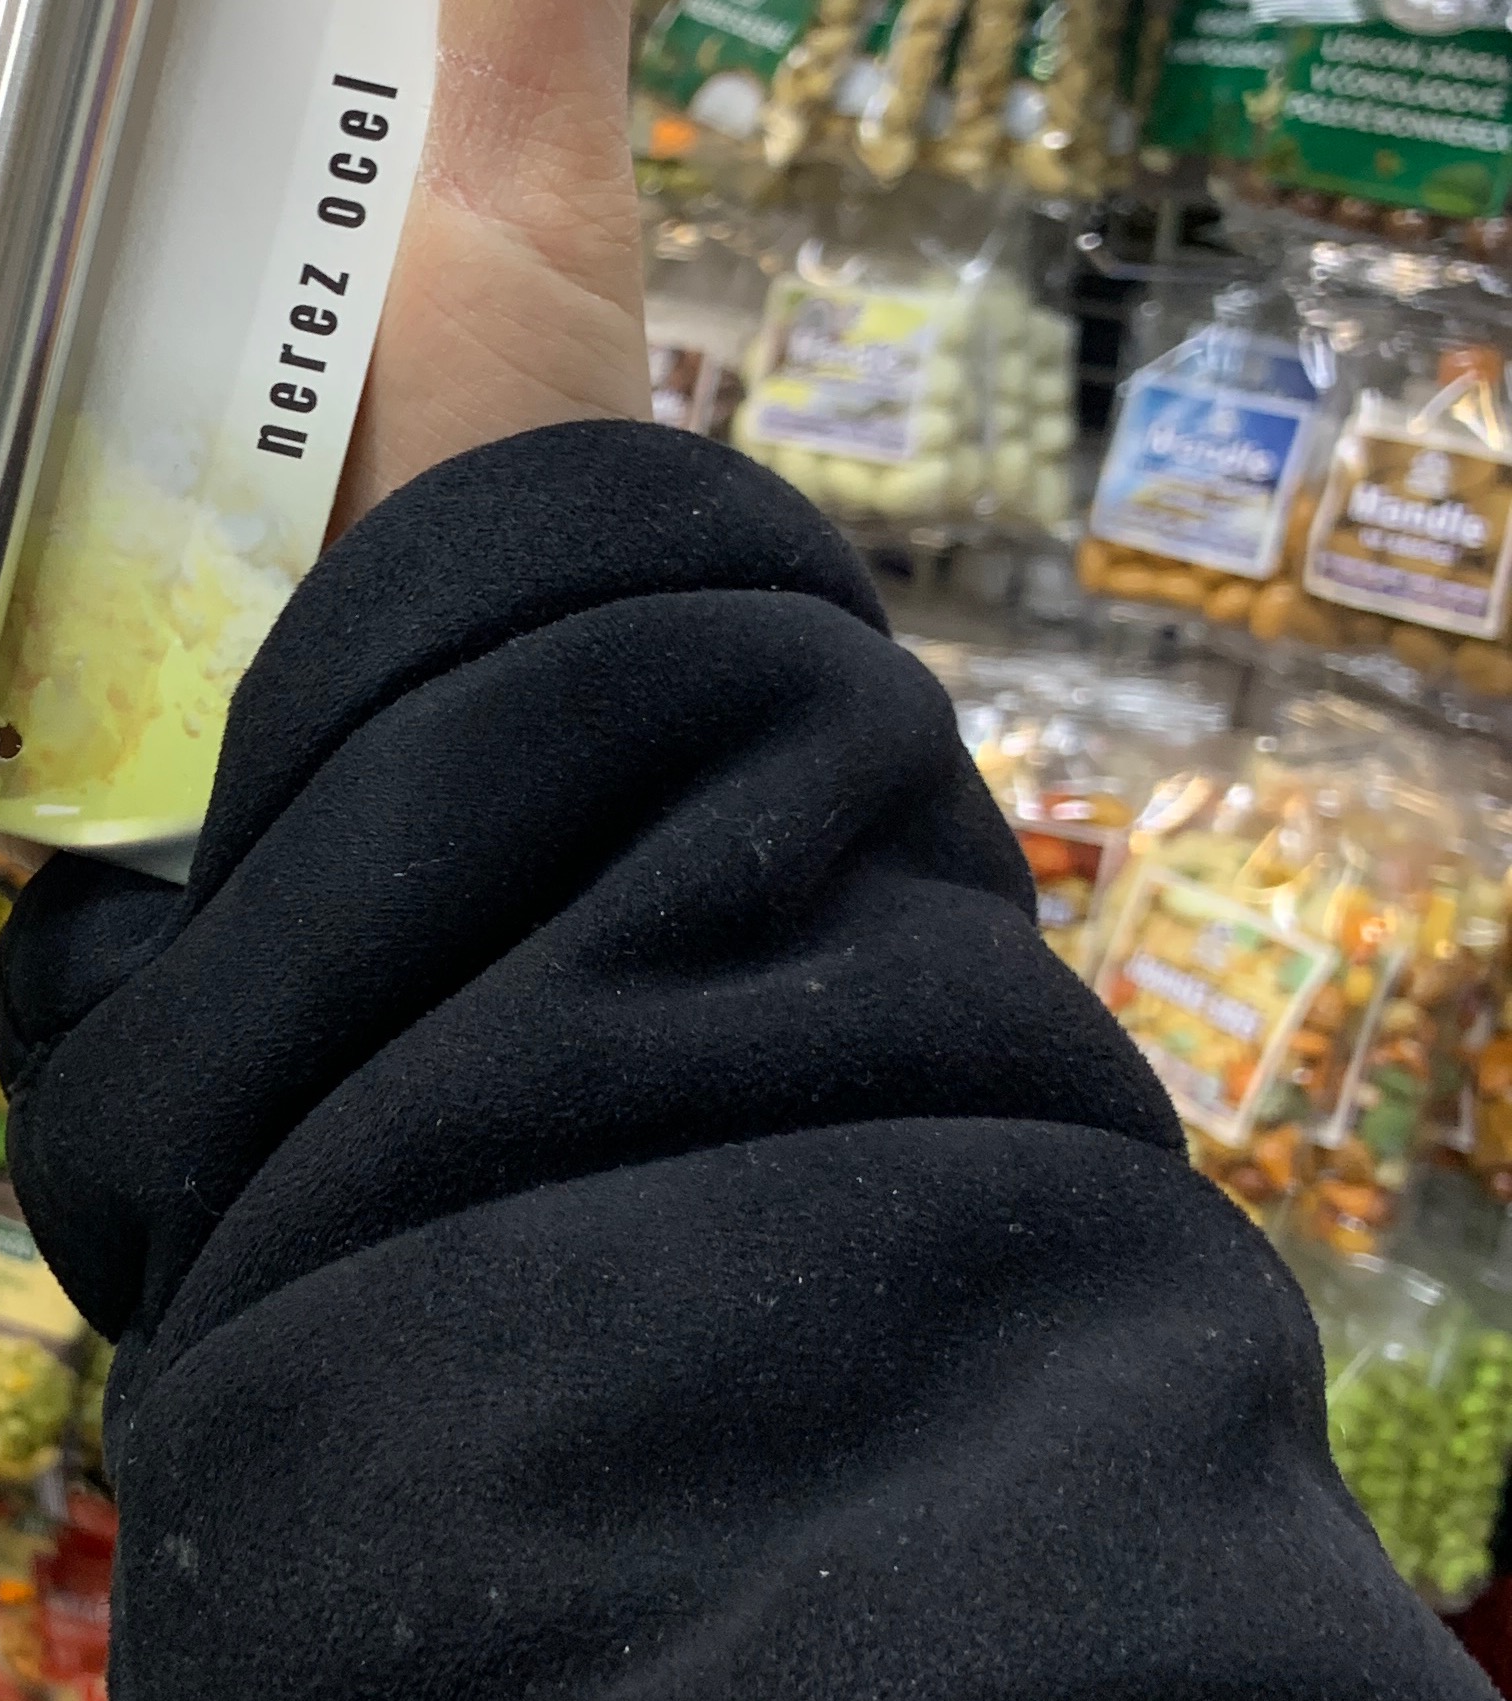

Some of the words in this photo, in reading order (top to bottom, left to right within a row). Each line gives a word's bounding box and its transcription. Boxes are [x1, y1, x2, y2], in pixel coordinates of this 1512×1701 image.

[257, 263, 350, 459] nerez
[317, 74, 398, 229] ocel
[1349, 482, 1489, 549] Mandle
